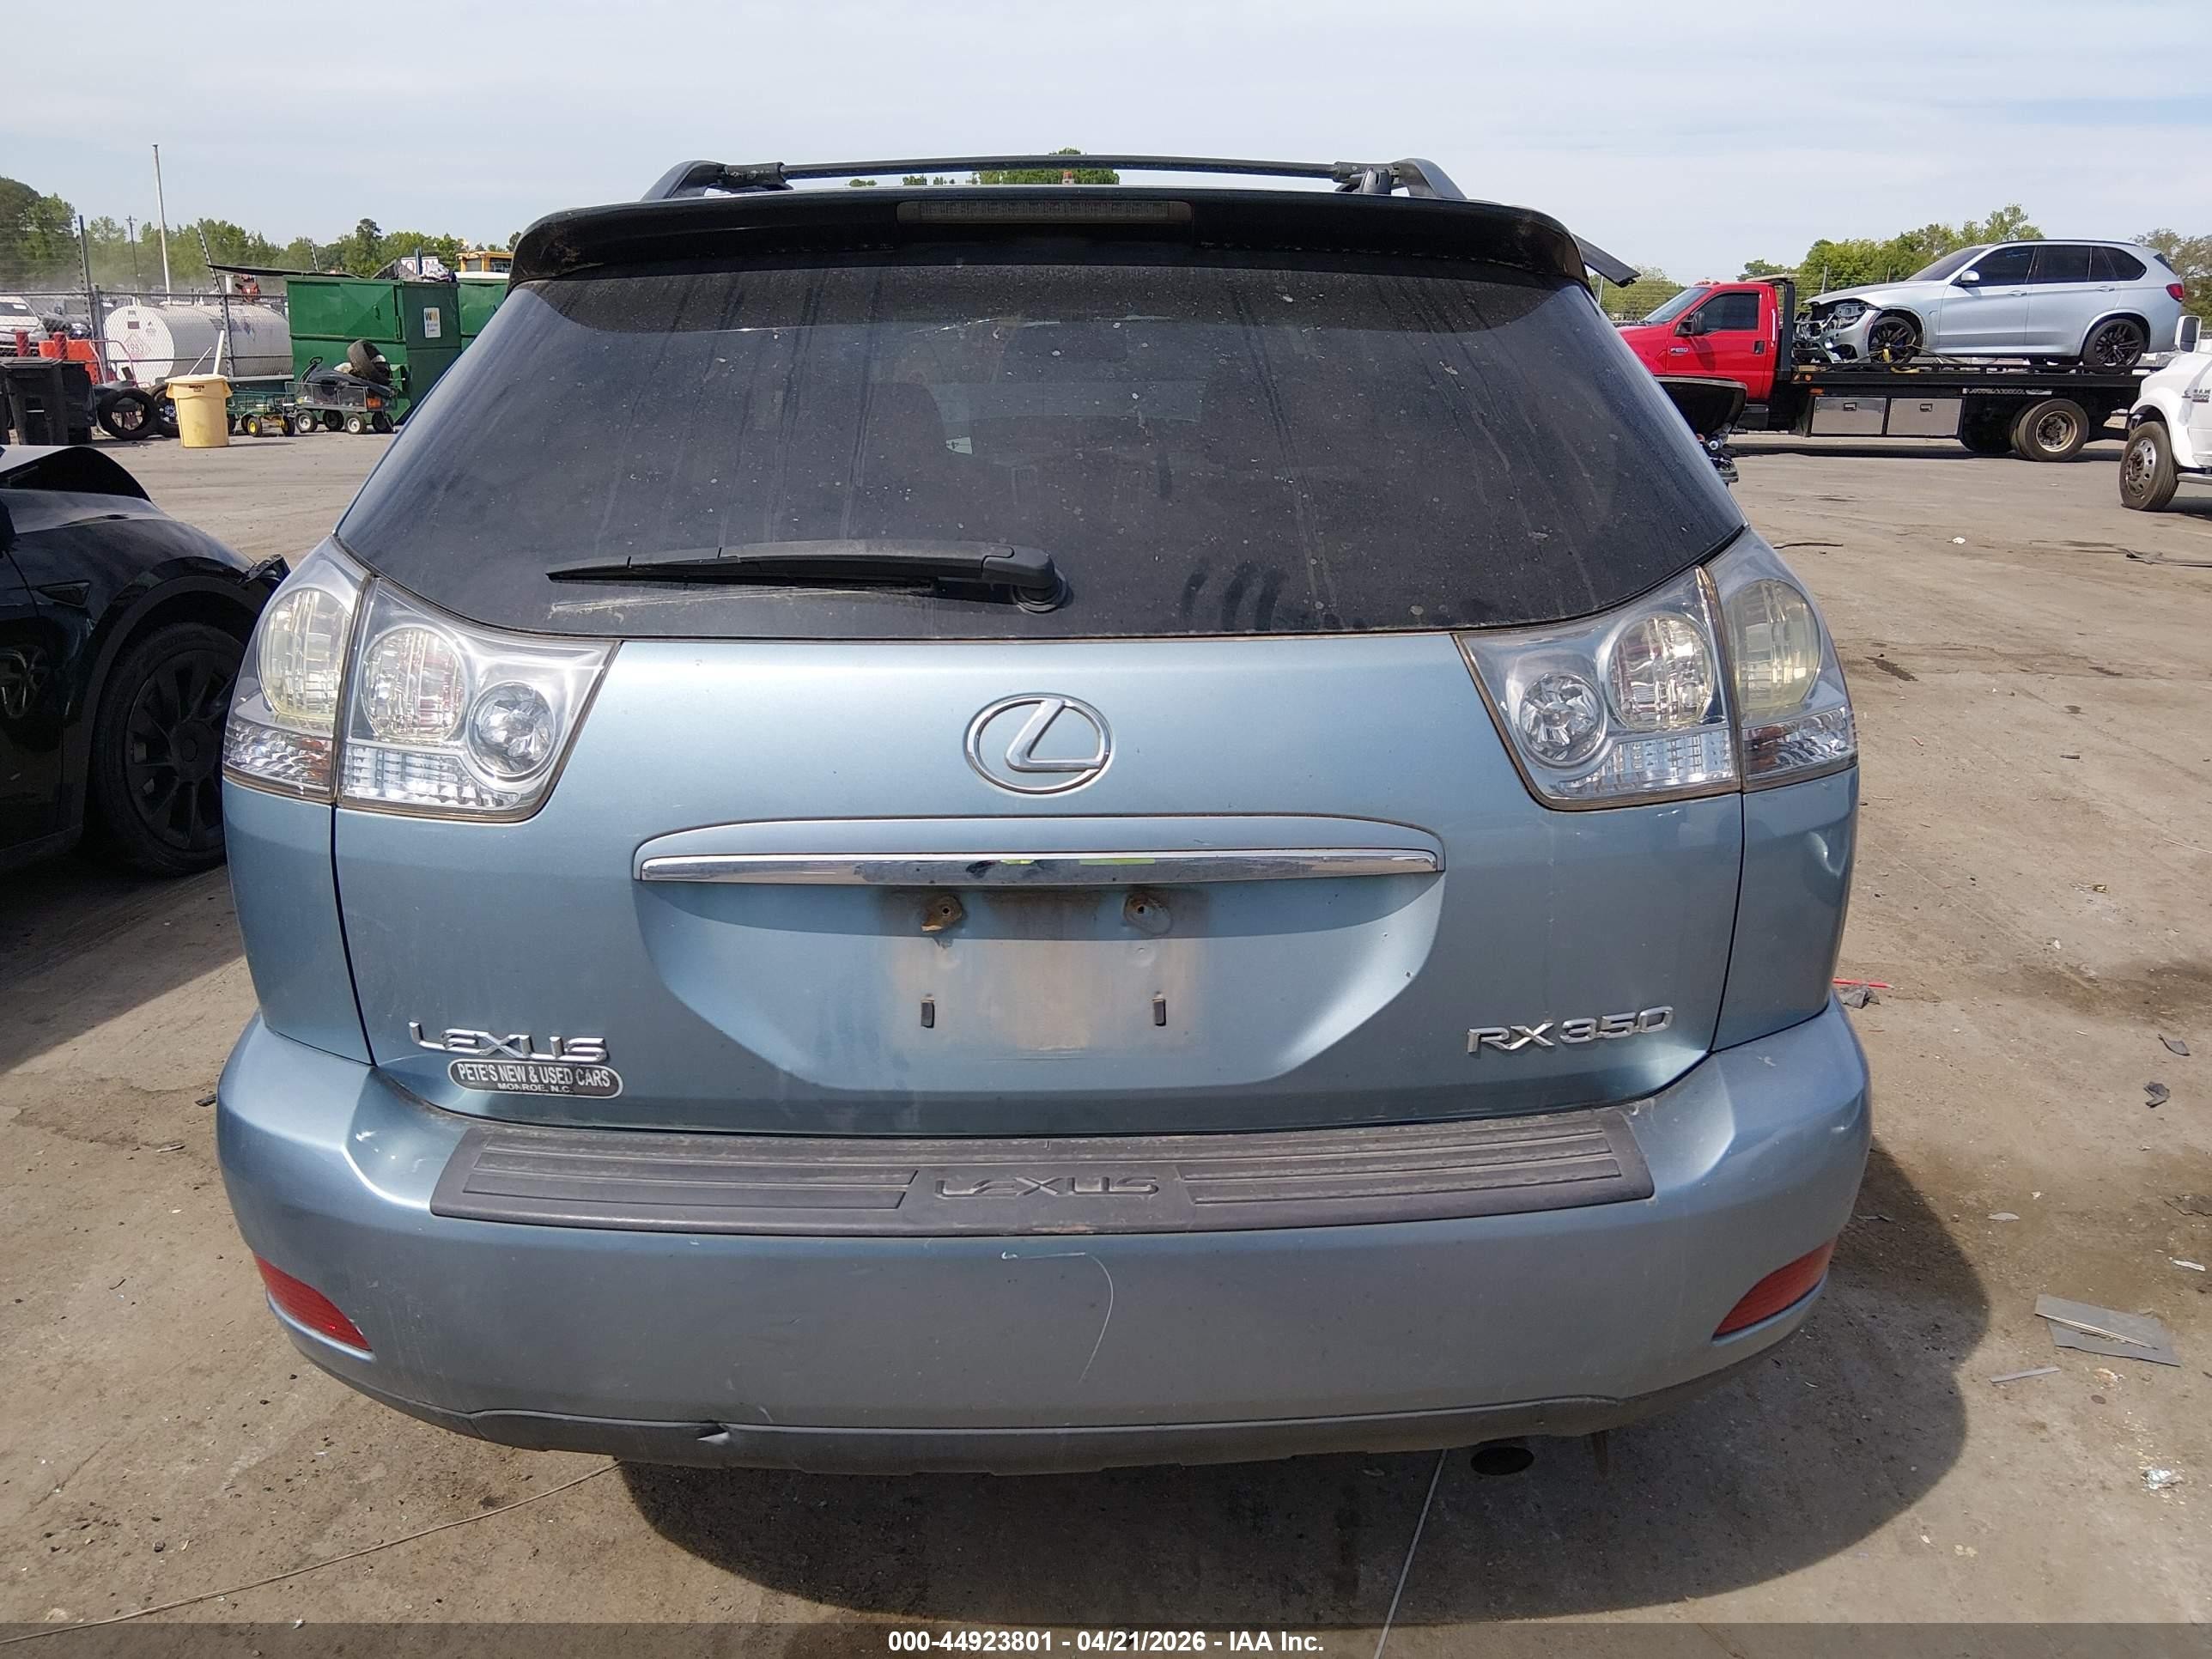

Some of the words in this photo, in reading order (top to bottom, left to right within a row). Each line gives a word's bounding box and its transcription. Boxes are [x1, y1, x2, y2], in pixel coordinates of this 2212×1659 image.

[408, 1021, 609, 1062] LEXUS
[1467, 1021, 1555, 1054] RX
[1559, 1006, 1674, 1044] 350
[457, 1063, 498, 1082] PETE'S
[498, 1065, 527, 1084] NEW
[529, 1066, 538, 1083] &
[538, 1066, 574, 1085] USED
[574, 1068, 611, 1088] CARS
[935, 1176, 1159, 1199] LEXUS
